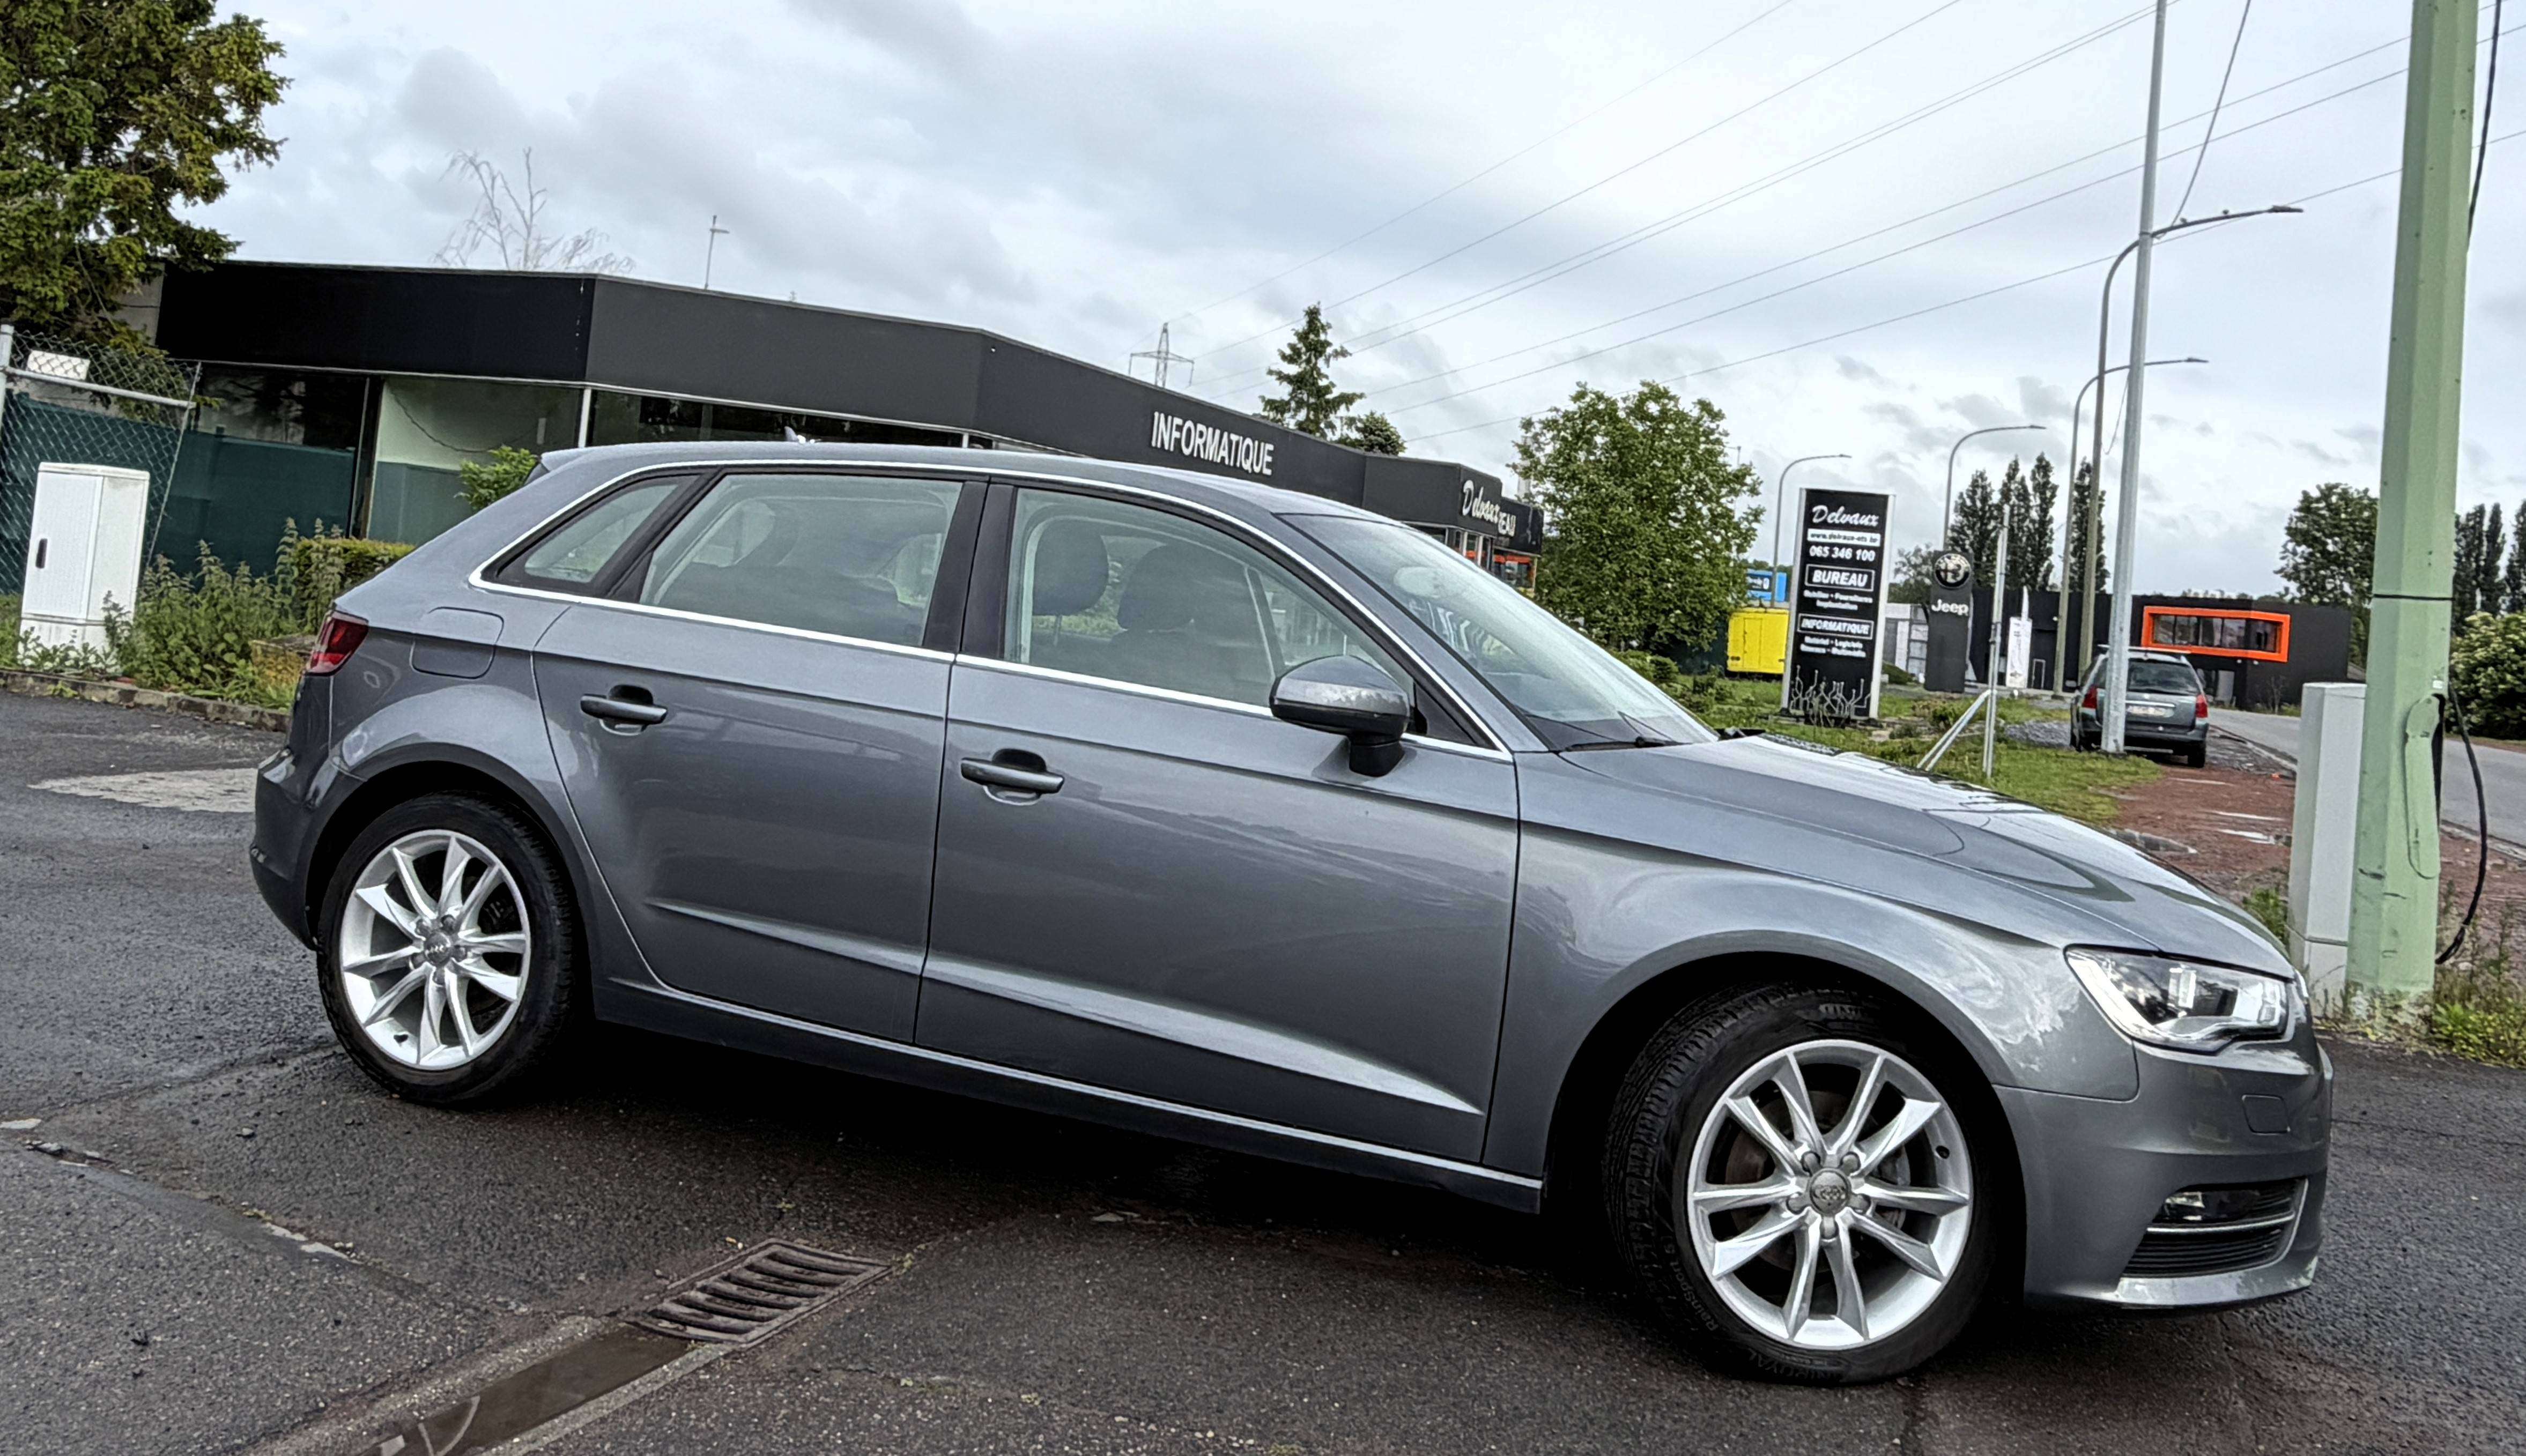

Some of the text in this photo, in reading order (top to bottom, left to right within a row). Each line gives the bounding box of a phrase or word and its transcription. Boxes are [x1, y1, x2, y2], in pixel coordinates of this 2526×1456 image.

[1151, 411, 1274, 476] INFORMATIQUE
[1812, 505, 1879, 527] Delvaux
[1810, 545, 1876, 562] 065 346 100
[1812, 569, 1868, 587] BUREAU
[1931, 598, 1969, 616] Jeep
[1801, 618, 1870, 635] INFORMATIQUE
